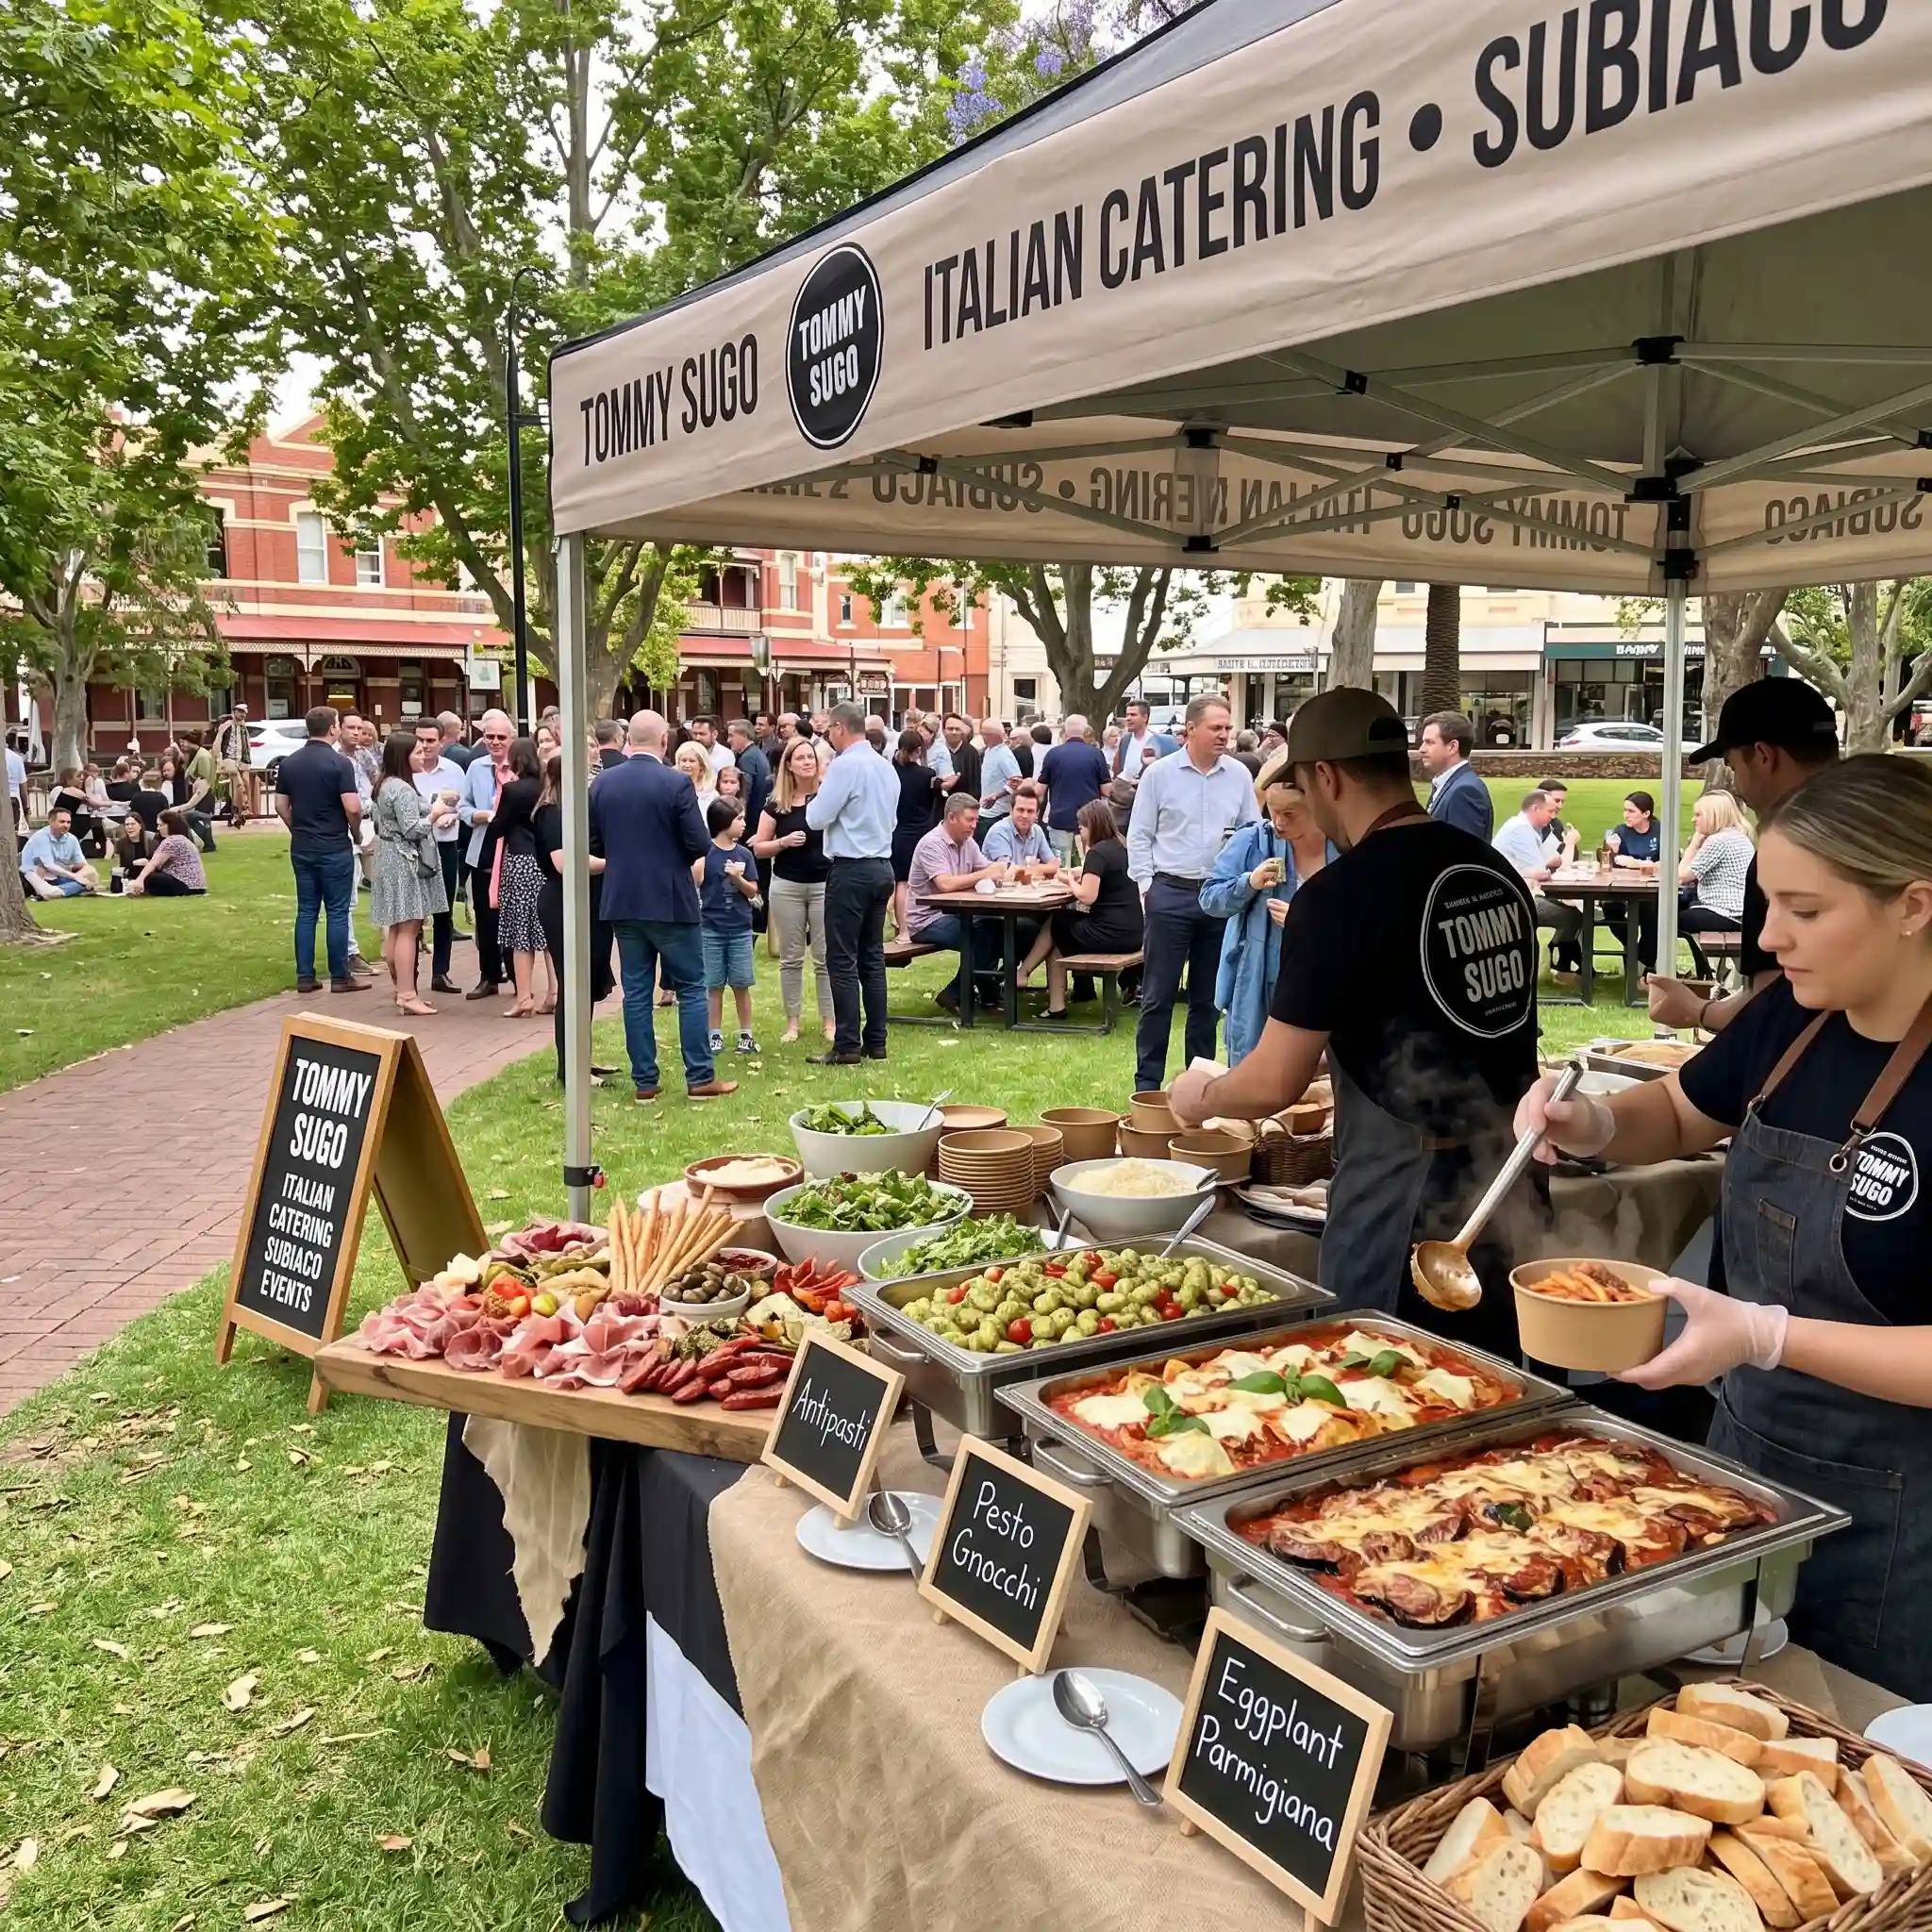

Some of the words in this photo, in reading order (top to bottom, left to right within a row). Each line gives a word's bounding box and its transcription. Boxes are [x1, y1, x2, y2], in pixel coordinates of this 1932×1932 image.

[923, 204, 1084, 350] ITALIAN
[1098, 90, 1381, 289] CATERING
[798, 284, 868, 356] TOMMY
[580, 366, 674, 466] TOMMY
[681, 333, 758, 434] SUGO
[808, 343, 859, 408] SUGO
[1438, 902, 1523, 958] TOMMY
[1464, 949, 1524, 1003] SUGO
[292, 1058, 372, 1119] TOMMY
[290, 1112, 348, 1170] SUGO
[1857, 1150, 1910, 1189] TOMMY
[282, 1173, 335, 1213] ITALIAN
[1850, 1173, 1893, 1206] SUGO
[268, 1203, 334, 1248] CATERING
[264, 1236, 323, 1280] SUBIACO
[259, 1269, 313, 1312] EVENTS
[791, 1377, 871, 1451] Antipasti
[974, 1480, 1034, 1549] Pesto
[952, 1527, 1041, 1610] Gnocchi
[1217, 1657, 1343, 1770] Eggplant
[1195, 1714, 1333, 1852] Parmigiana
